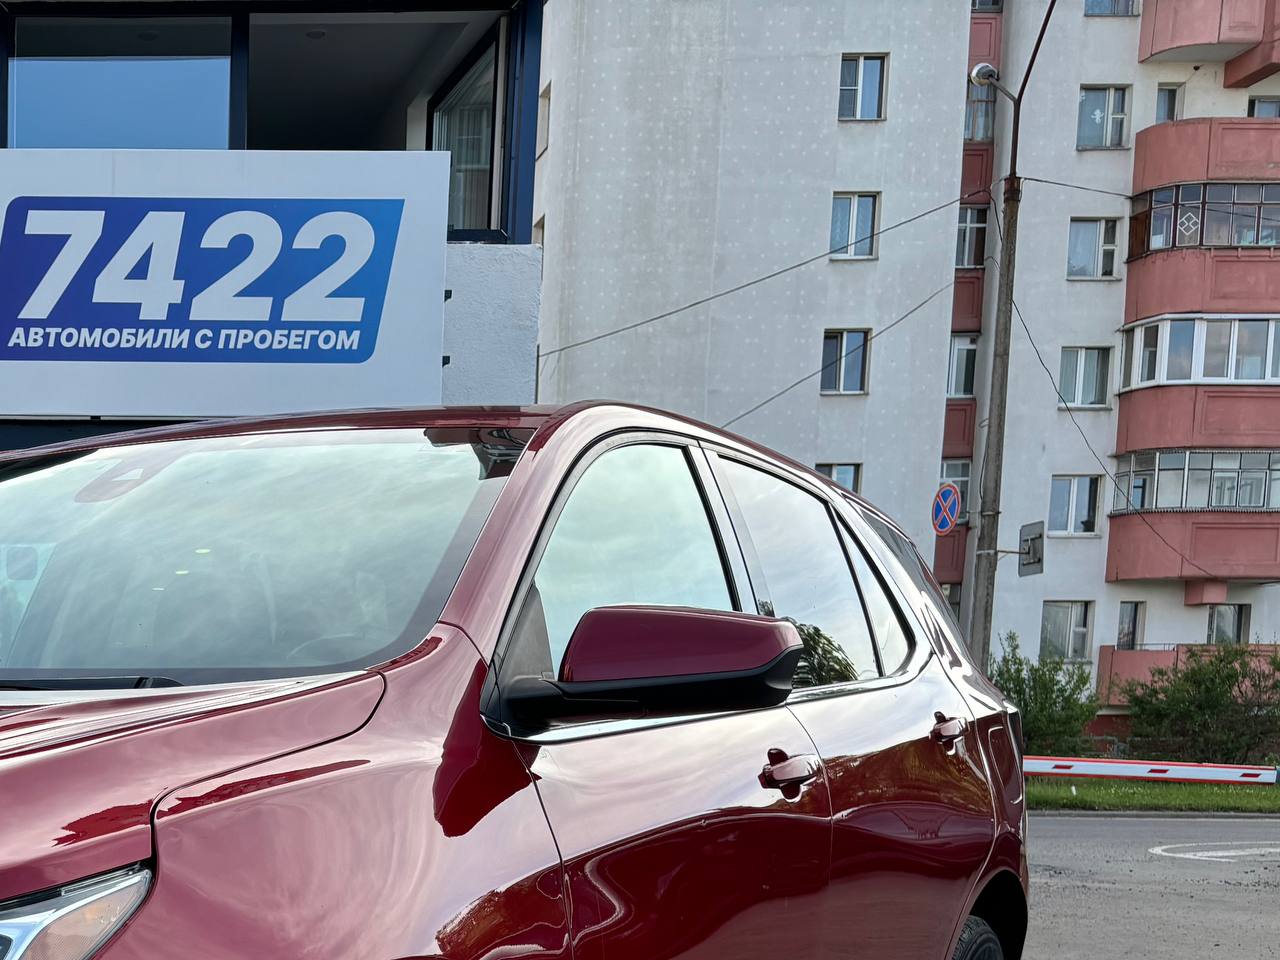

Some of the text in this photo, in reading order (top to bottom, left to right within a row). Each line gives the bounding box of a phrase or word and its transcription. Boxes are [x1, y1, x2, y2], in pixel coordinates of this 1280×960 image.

[17, 209, 376, 323] 7422
[7, 326, 361, 352] АВТОМОБИЛИ С ПРОБЕГОМ
